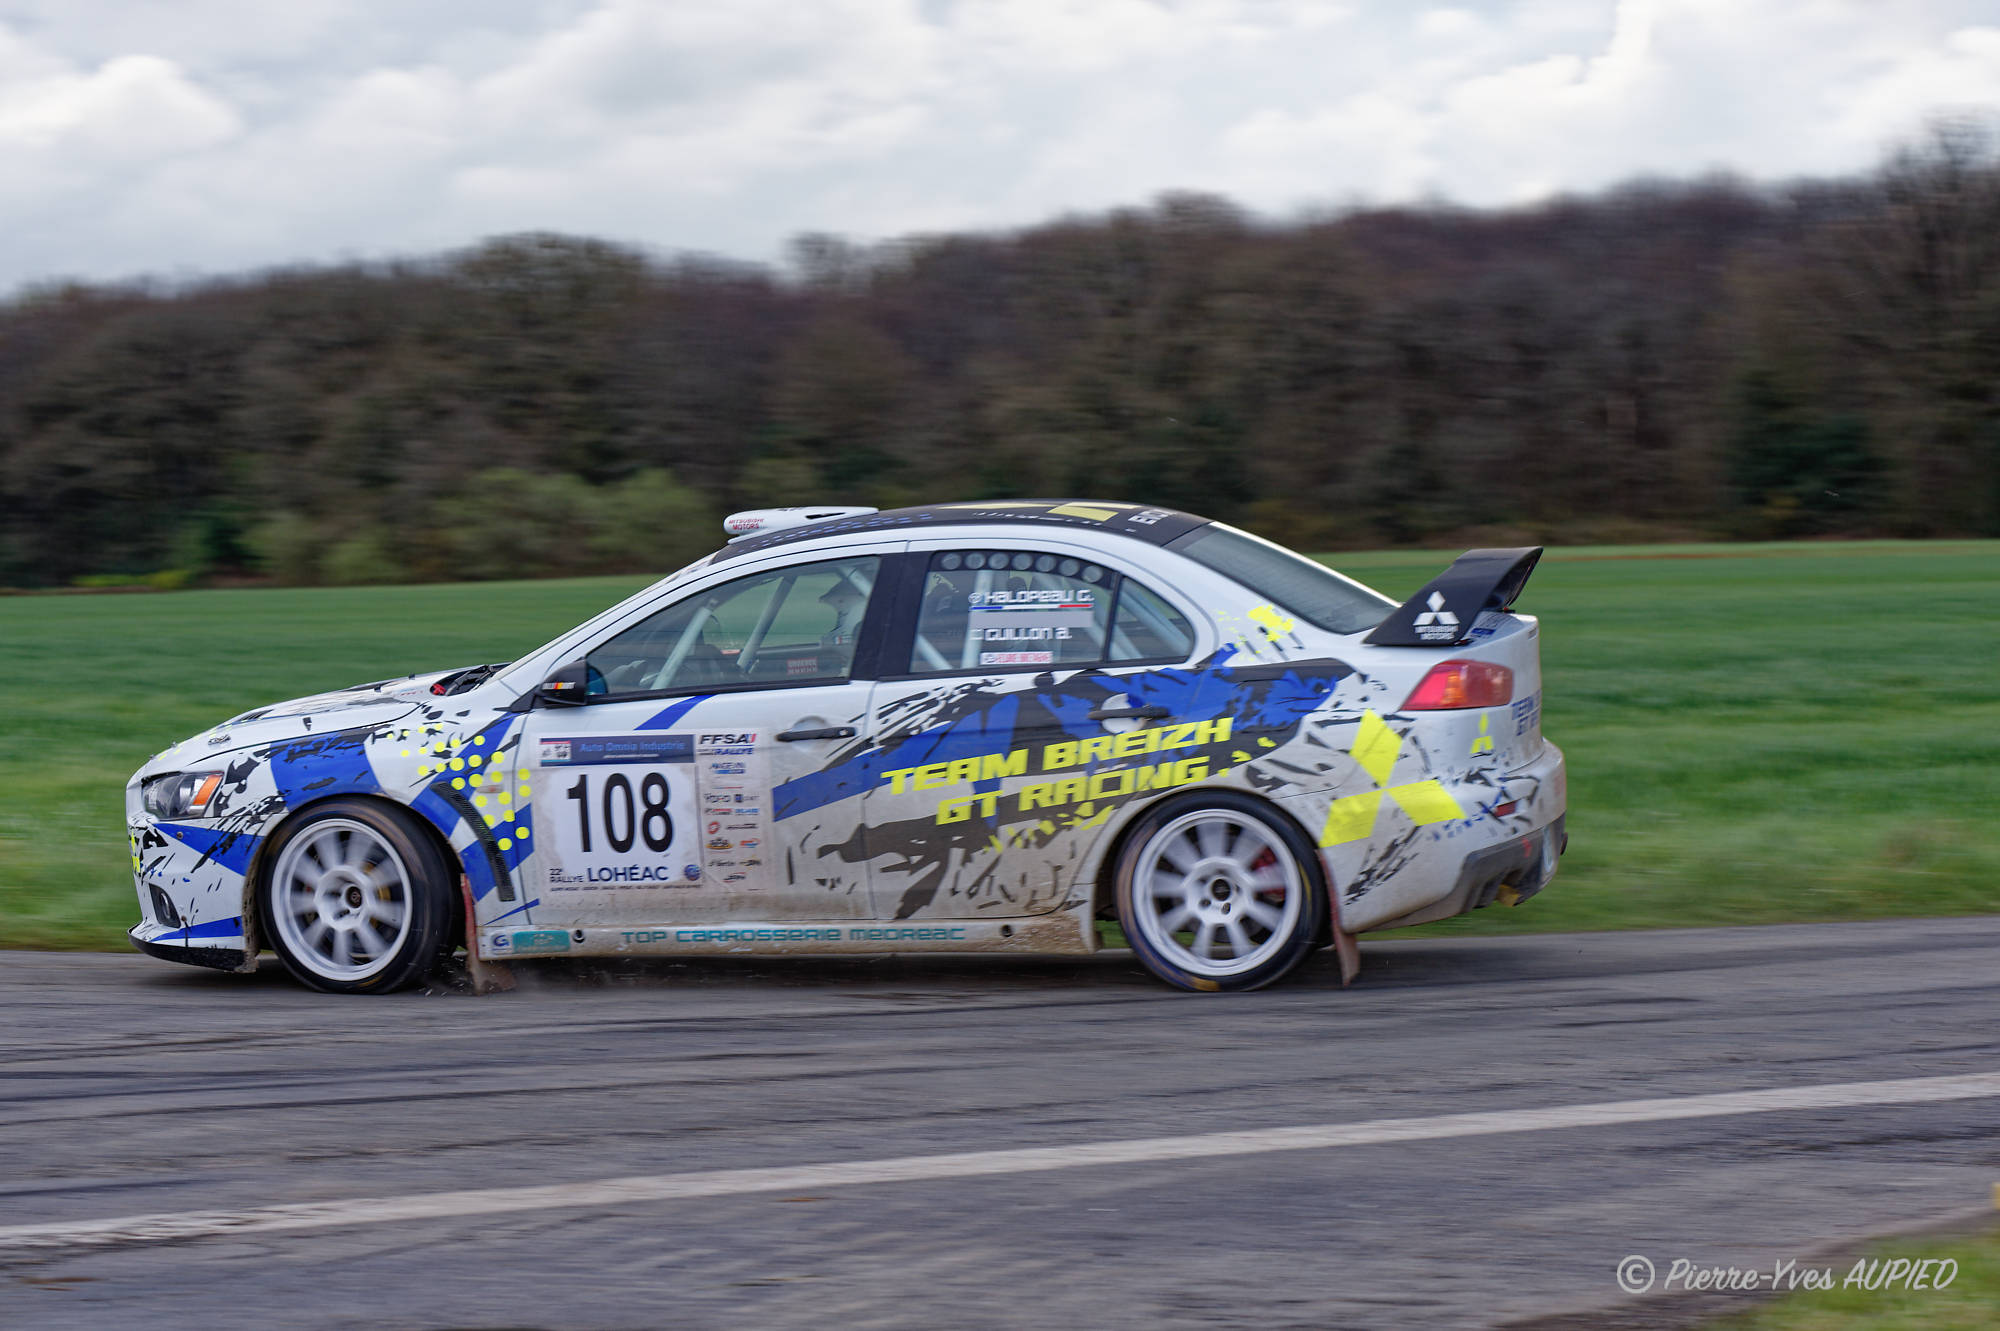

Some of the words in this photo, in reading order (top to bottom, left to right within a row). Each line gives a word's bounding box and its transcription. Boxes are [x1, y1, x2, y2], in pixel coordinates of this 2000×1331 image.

[699, 734, 752, 745] FFSA
[880, 749, 1029, 795] TEAM
[1042, 717, 1234, 771] BREIZH
[567, 772, 675, 854] 108
[936, 790, 1004, 826] GT
[1018, 756, 1210, 812] RACING
[587, 864, 669, 882] LOHÉAC
[620, 931, 668, 944] TOP
